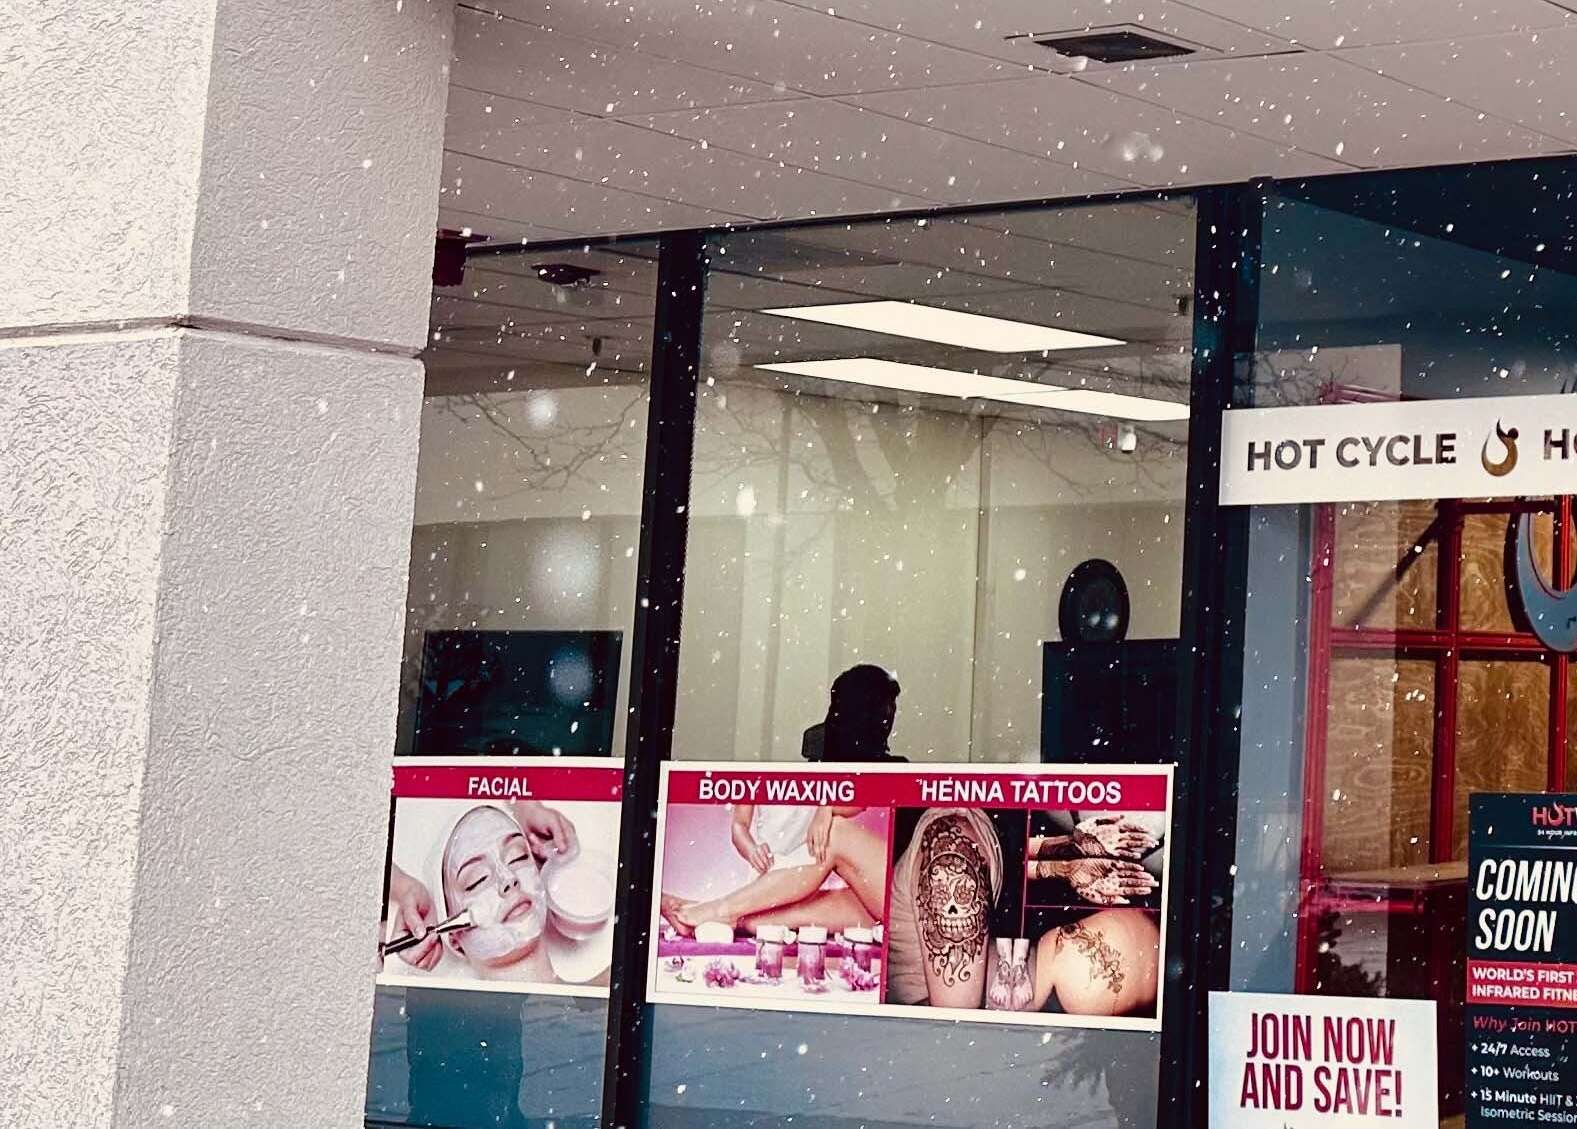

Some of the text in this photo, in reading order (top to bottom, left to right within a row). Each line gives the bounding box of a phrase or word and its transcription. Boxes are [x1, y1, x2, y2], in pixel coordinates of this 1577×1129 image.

[1248, 438, 1325, 471] HOT
[1335, 433, 1456, 467] CYCLE
[467, 776, 533, 798] FACIAL
[699, 779, 854, 803] BODY WAXING
[922, 779, 1121, 805] HENNA TATTOOS
[1475, 908, 1557, 952] SOON
[1472, 967, 1535, 981] WORLD'S
[1538, 970, 1574, 984] FIRST
[1472, 984, 1540, 1000] INFRARED
[1473, 1015, 1507, 1032] Why
[1512, 1018, 1541, 1032] Join
[1246, 1012, 1396, 1065] JOIN NOW
[1481, 1041, 1551, 1058] 24/7 Access
[1480, 1065, 1560, 1081] 10+ Workouts
[1240, 1062, 1404, 1117] AND SAVE!
[1480, 1088, 1492, 1101] 15
[1495, 1090, 1537, 1104] Minute
[1565, 1095, 1574, 1107] &
[1481, 1106, 1535, 1121] Isometric
